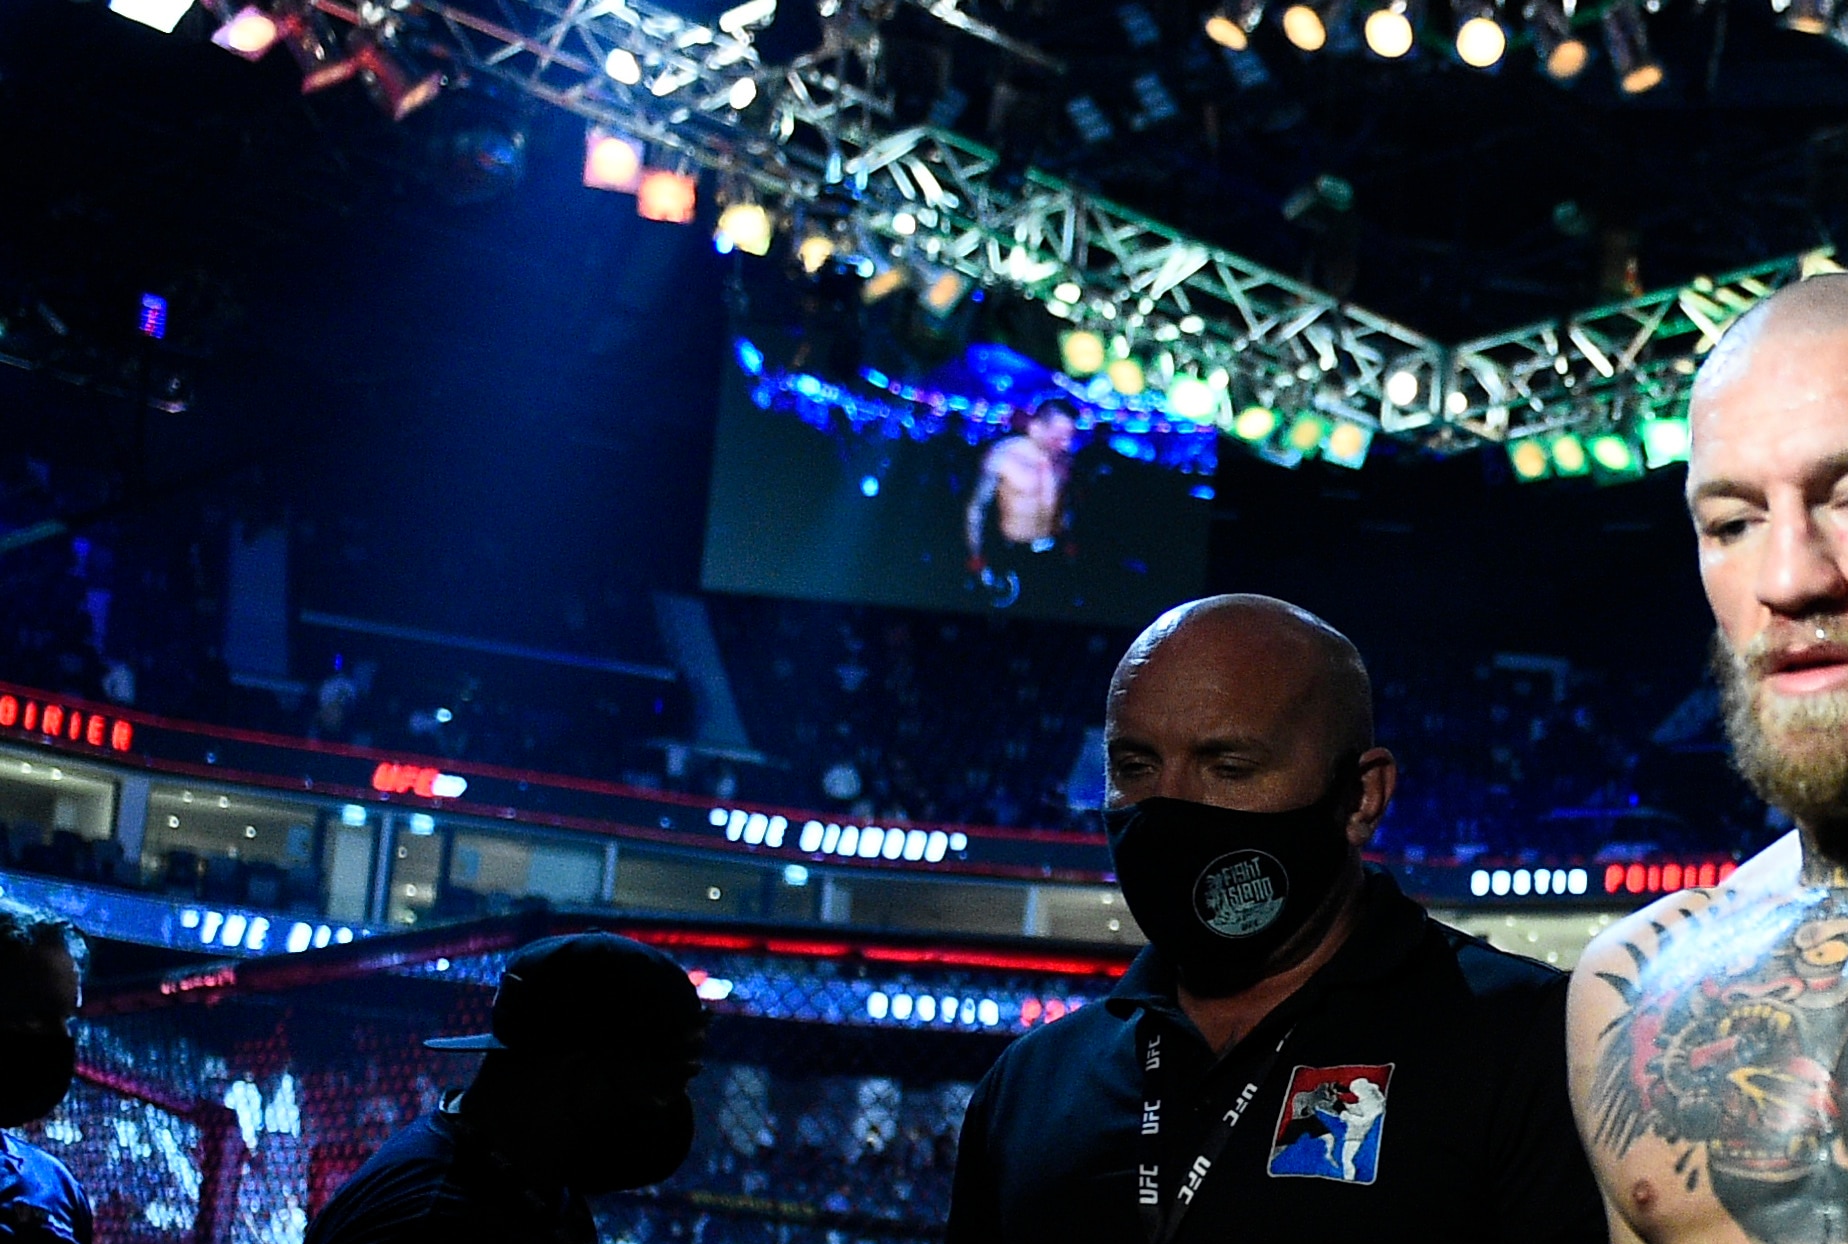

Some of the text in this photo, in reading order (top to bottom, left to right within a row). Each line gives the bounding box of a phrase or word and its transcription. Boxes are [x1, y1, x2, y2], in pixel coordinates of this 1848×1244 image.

[1145, 1034, 1161, 1072] UFC
[1140, 1099, 1161, 1136] UFC
[1222, 1082, 1259, 1128] UFC
[1138, 1163, 1159, 1205] UFC
[1176, 1155, 1212, 1206] UFC
